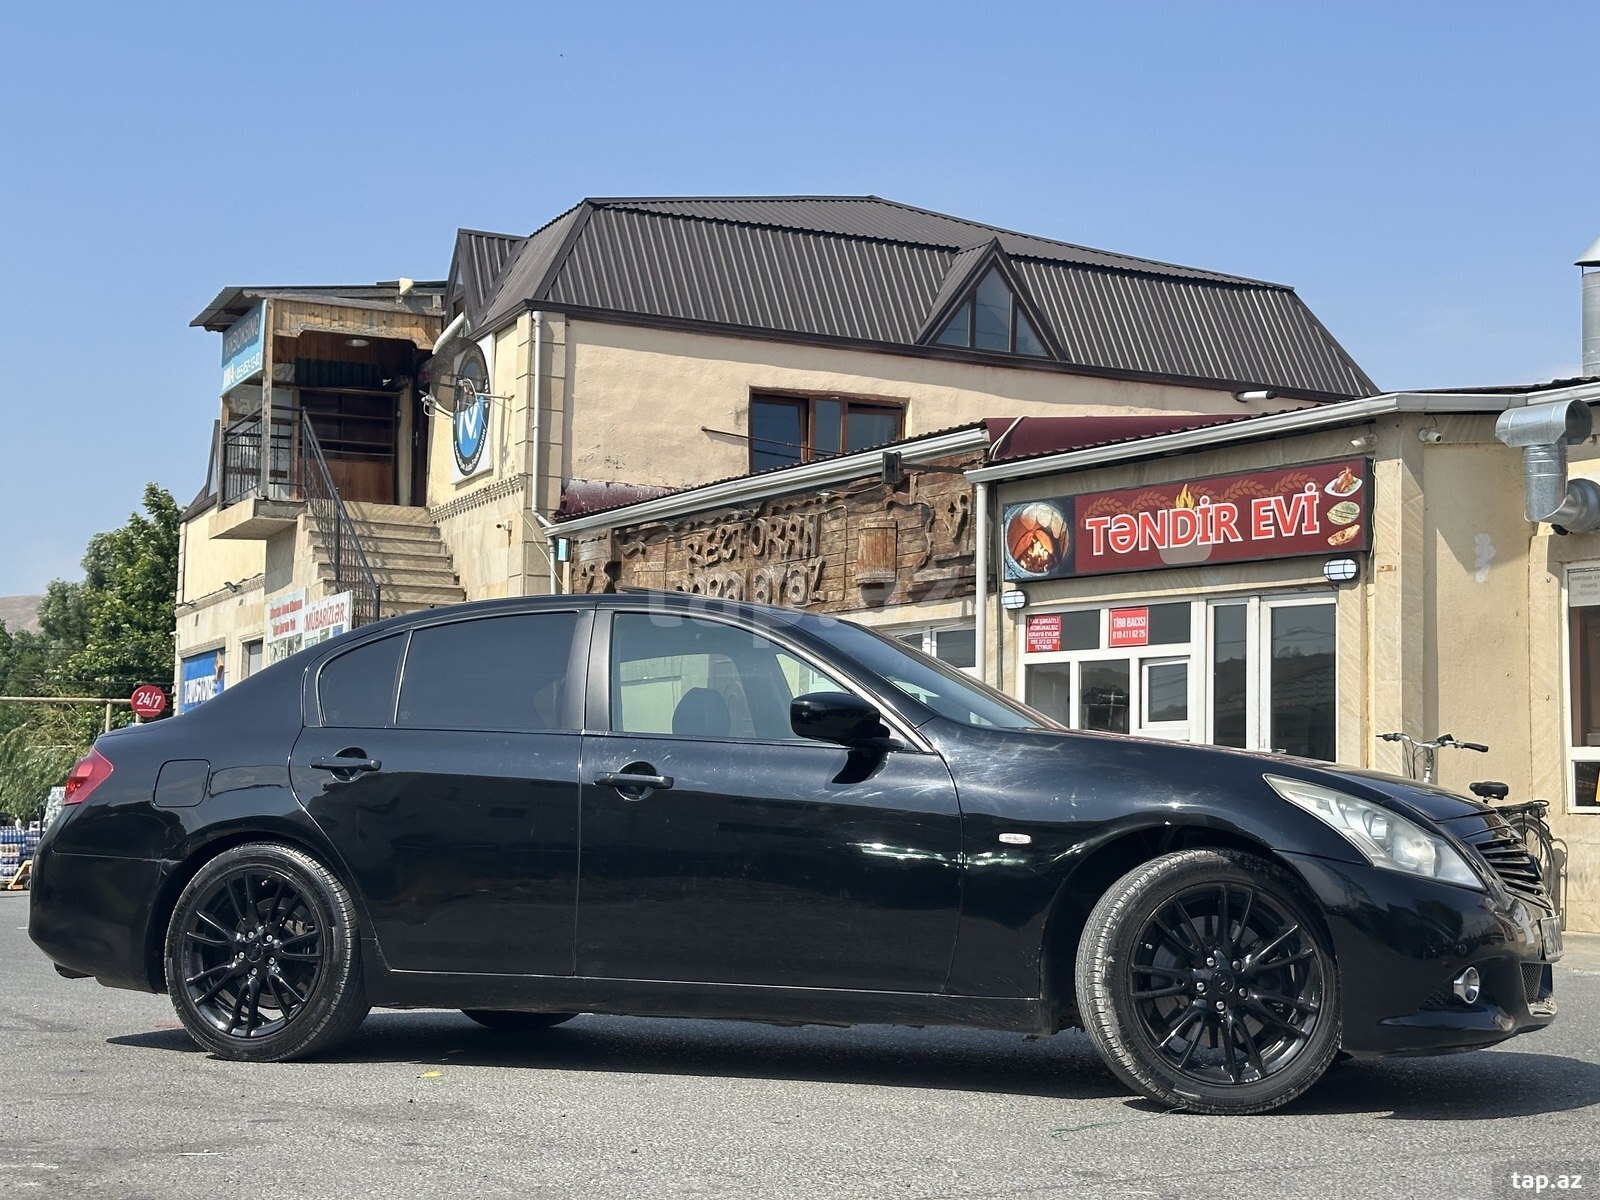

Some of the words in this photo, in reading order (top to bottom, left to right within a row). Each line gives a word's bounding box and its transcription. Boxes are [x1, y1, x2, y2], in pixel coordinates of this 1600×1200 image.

[1085, 495, 1243, 556] TƏNDİR
[1251, 482, 1320, 540] EVİ
[136, 691, 162, 709] 24/7
